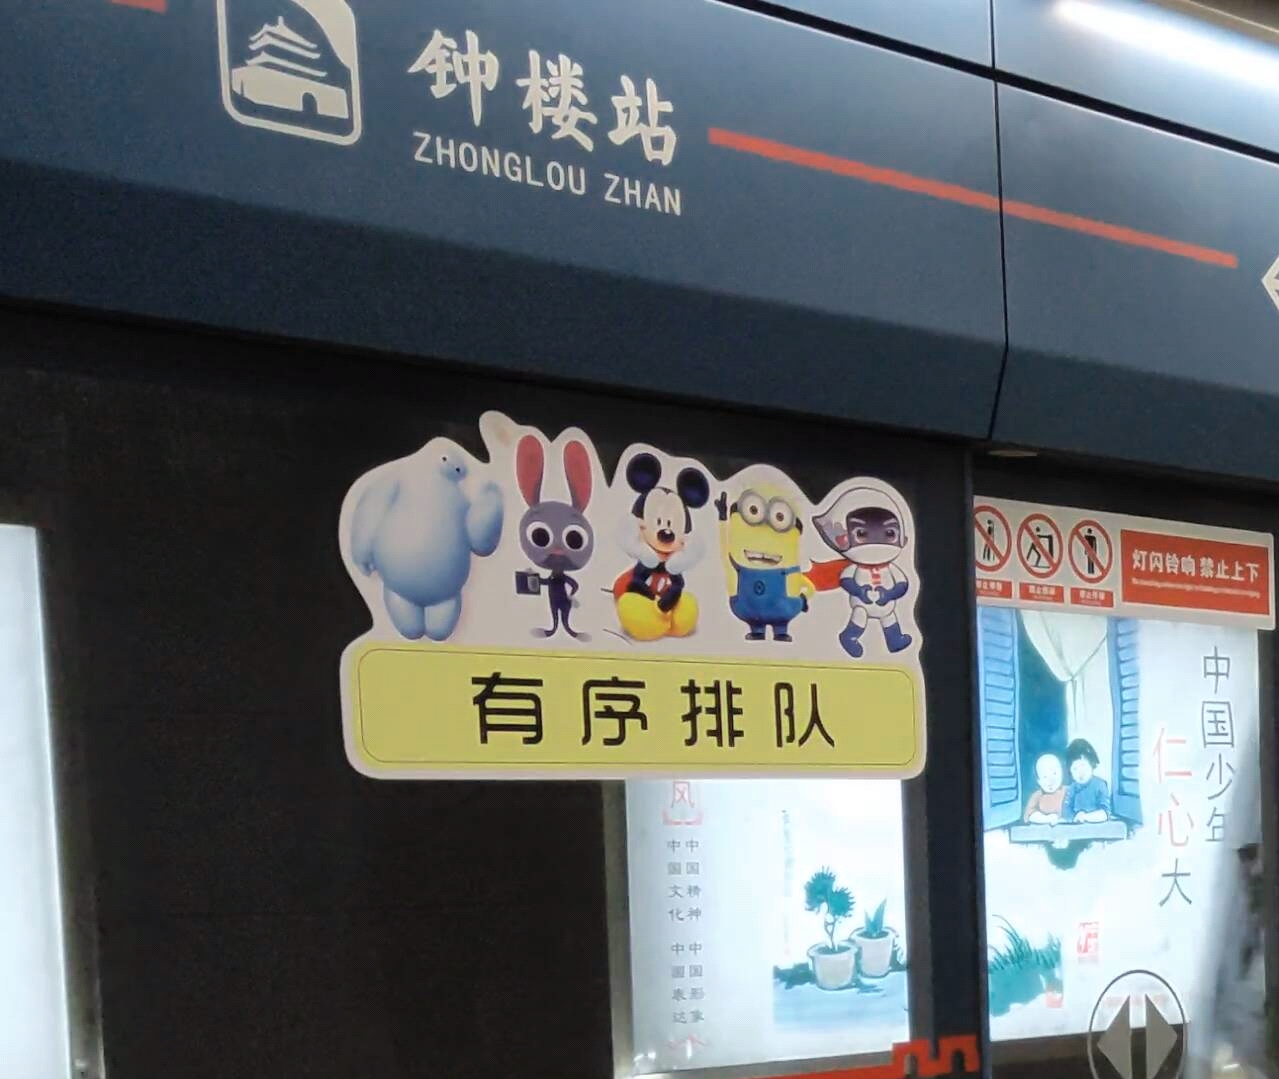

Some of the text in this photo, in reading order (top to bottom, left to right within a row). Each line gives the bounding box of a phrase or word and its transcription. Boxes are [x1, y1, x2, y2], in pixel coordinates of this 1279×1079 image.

[407, 28, 678, 167] 钟楼站
[412, 130, 682, 217] ZHONGLOU ZHAN
[1130, 548, 1261, 584] 灯闪铃响 禁止上下
[471, 671, 836, 749] 有序排队
